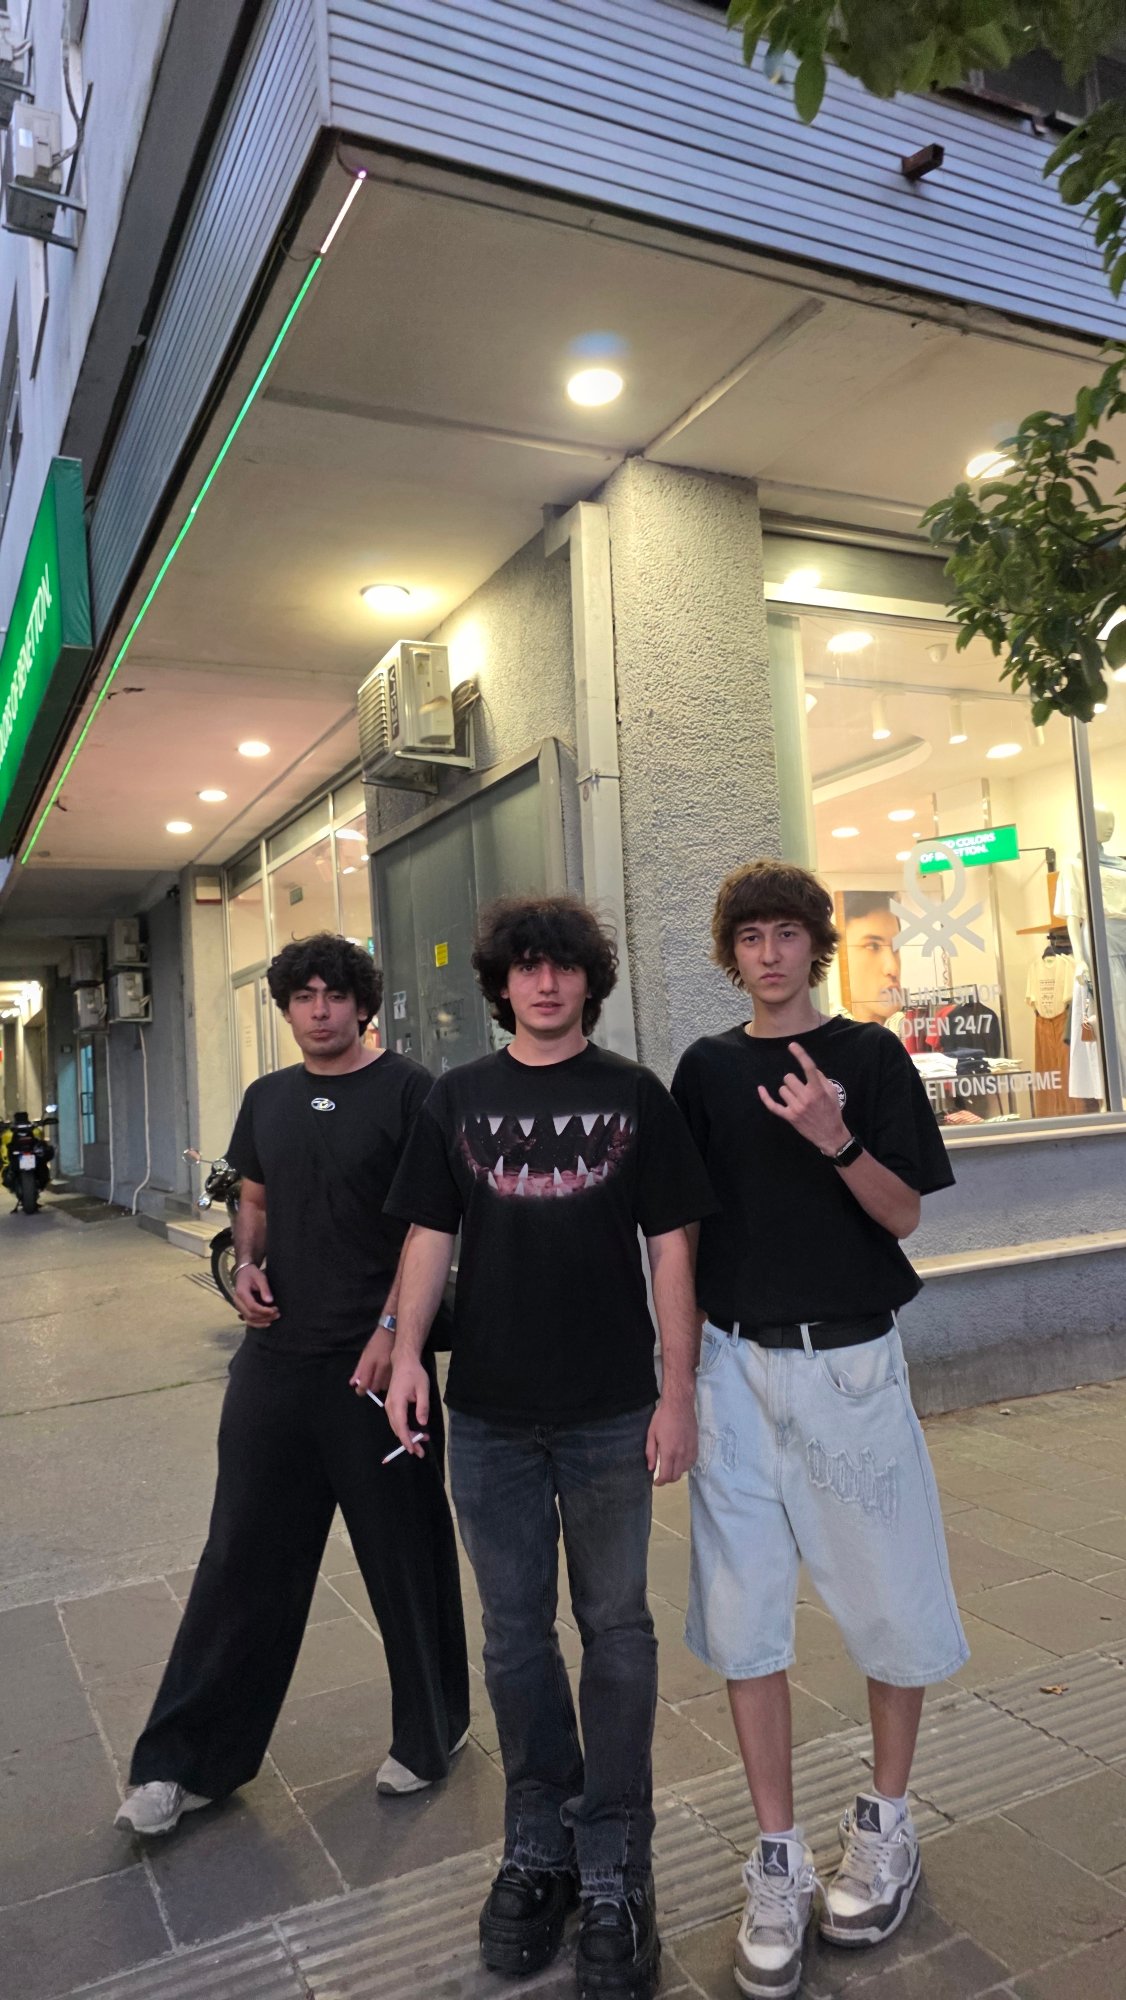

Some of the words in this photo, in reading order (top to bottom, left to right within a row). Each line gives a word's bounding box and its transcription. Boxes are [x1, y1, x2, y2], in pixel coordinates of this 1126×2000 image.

[880, 986, 949, 1008] ONLINE
[953, 983, 1001, 1005] SHOP
[900, 1016, 951, 1038] OPEN
[954, 1013, 993, 1035] 24/7
[925, 1070, 1063, 1100] ETTONSHOP.ME
